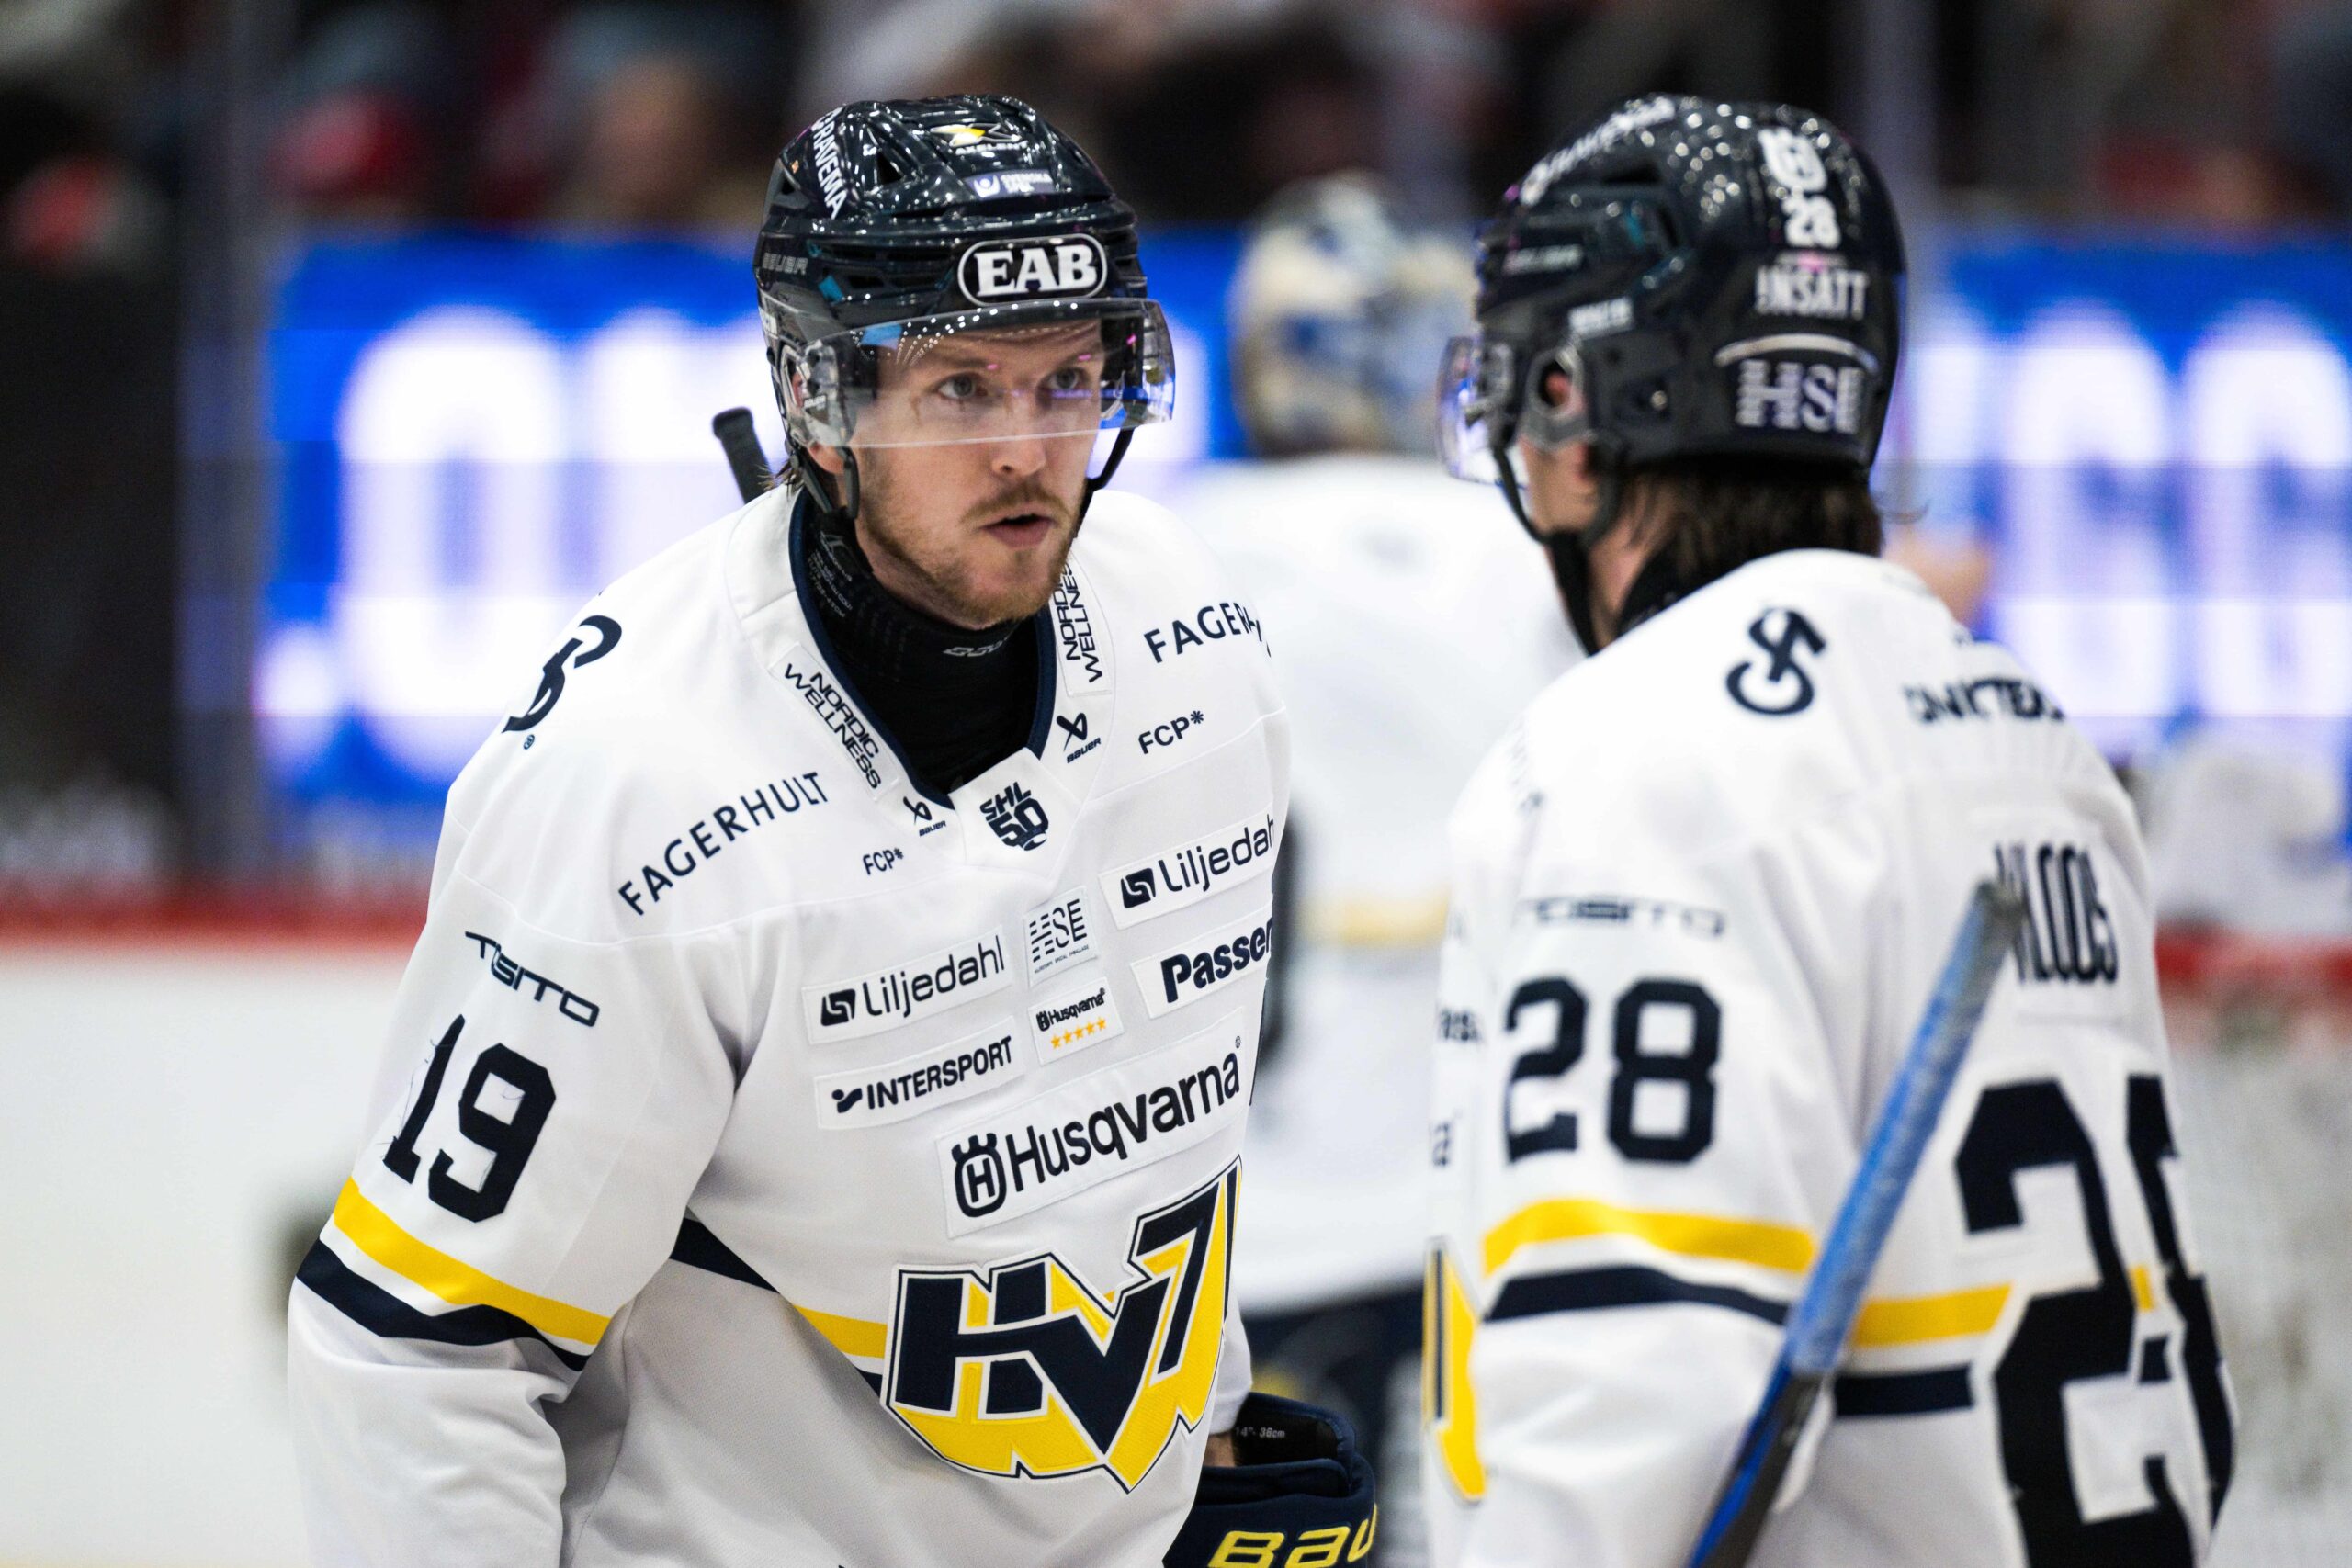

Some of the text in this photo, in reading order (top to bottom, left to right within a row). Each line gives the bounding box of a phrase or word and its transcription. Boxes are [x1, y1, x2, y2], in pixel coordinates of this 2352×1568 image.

[974, 245, 1098, 298] EAB
[1053, 582, 1081, 660] NORD
[1143, 602, 1272, 664] FAGERH
[785, 663, 882, 789] WELLNESS
[809, 672, 879, 759] NORDIC
[1067, 737, 1102, 764] BAUER
[919, 820, 947, 838] BAUER
[979, 782, 1032, 822] SHL
[988, 797, 1049, 848] 50
[618, 772, 828, 916] FAGERHULT
[1029, 898, 1088, 963] HSE
[862, 934, 1005, 1019] Liljedahl
[1048, 992, 1105, 1026] Husqvarna
[866, 1035, 1012, 1110] INTERSPORT
[1504, 973, 1723, 1165] 28
[382, 1013, 557, 1224] 19
[1005, 1052, 1240, 1192] Husqvarna
